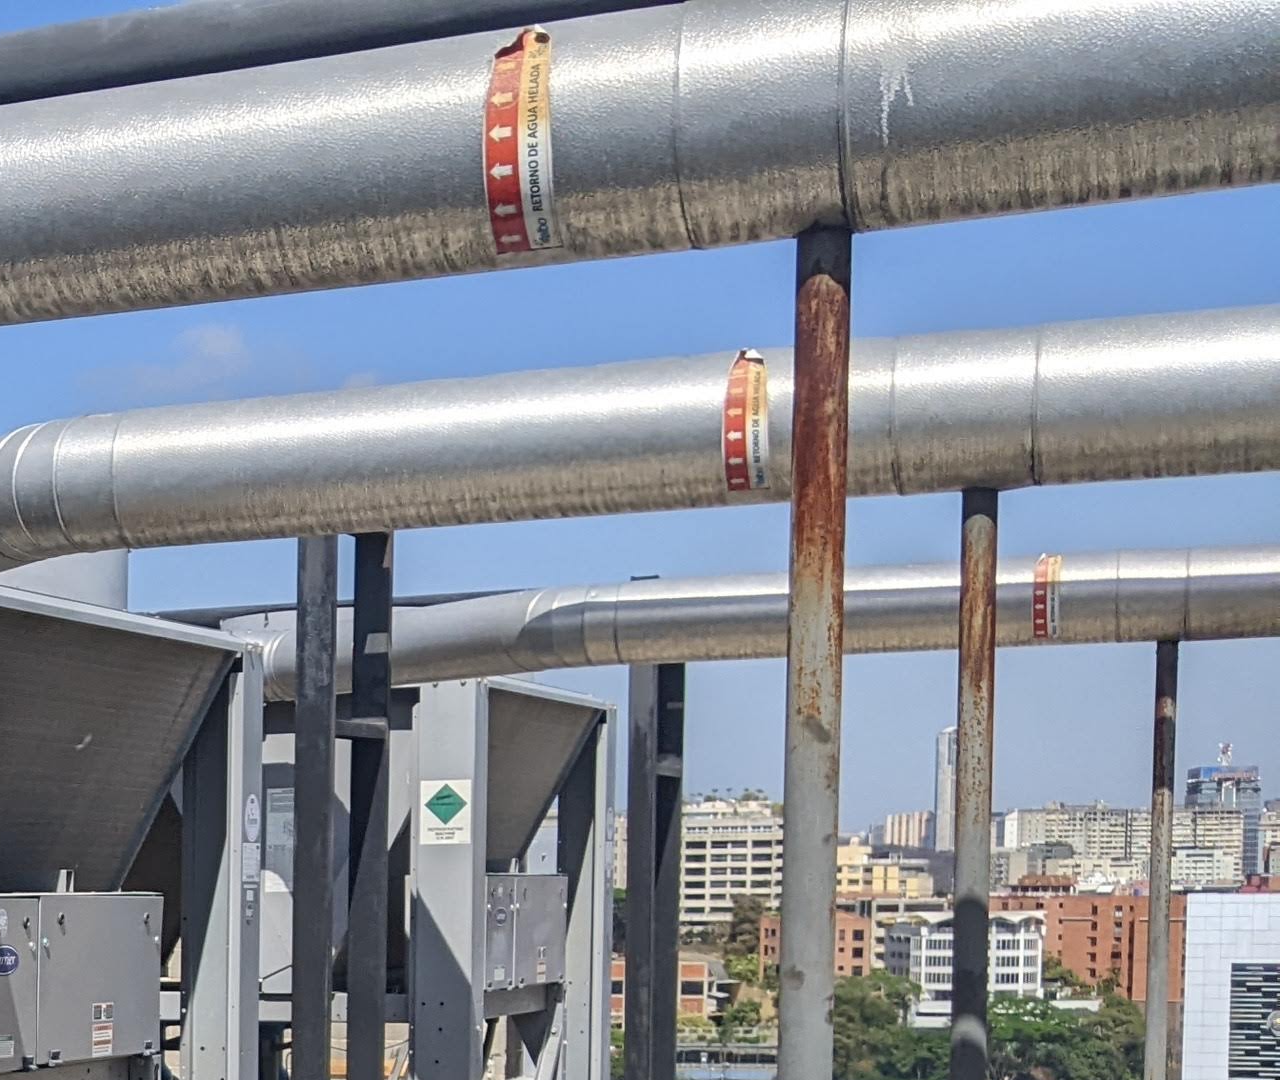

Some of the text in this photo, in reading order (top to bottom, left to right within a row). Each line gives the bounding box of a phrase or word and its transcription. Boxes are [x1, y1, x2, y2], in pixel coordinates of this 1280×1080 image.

[529, 63, 541, 101] HELADA
[527, 105, 538, 139] AGUA
[528, 142, 538, 158] DE
[527, 160, 542, 212] RETORNO
[752, 418, 759, 428] DE
[752, 430, 761, 464] RETORNO
